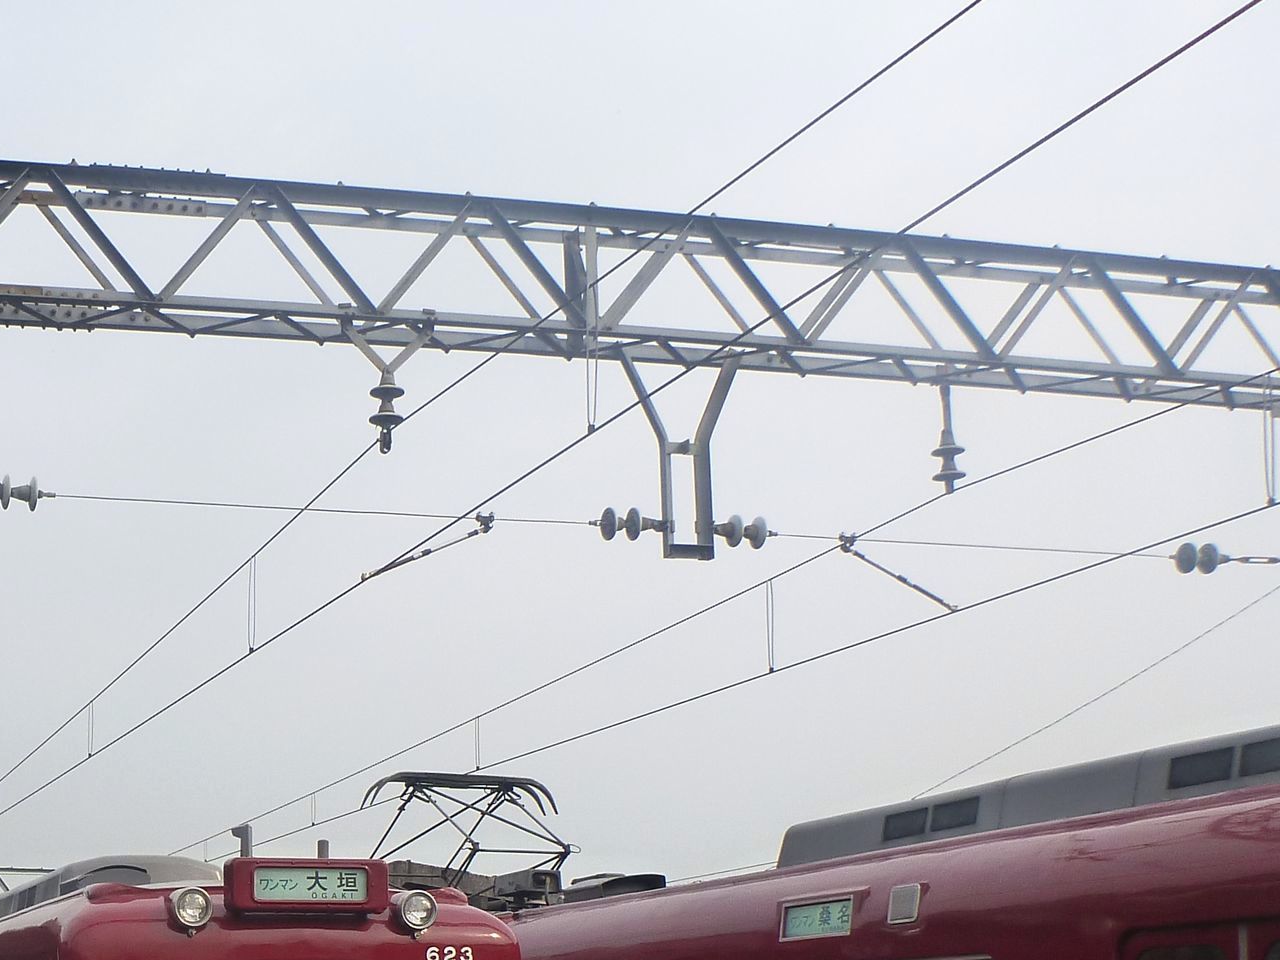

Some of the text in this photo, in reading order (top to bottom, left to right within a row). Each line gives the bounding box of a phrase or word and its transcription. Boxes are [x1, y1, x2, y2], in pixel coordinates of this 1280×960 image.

[260, 870, 359, 892] ワンマン 大垣
[818, 904, 850, 927] 桑名
